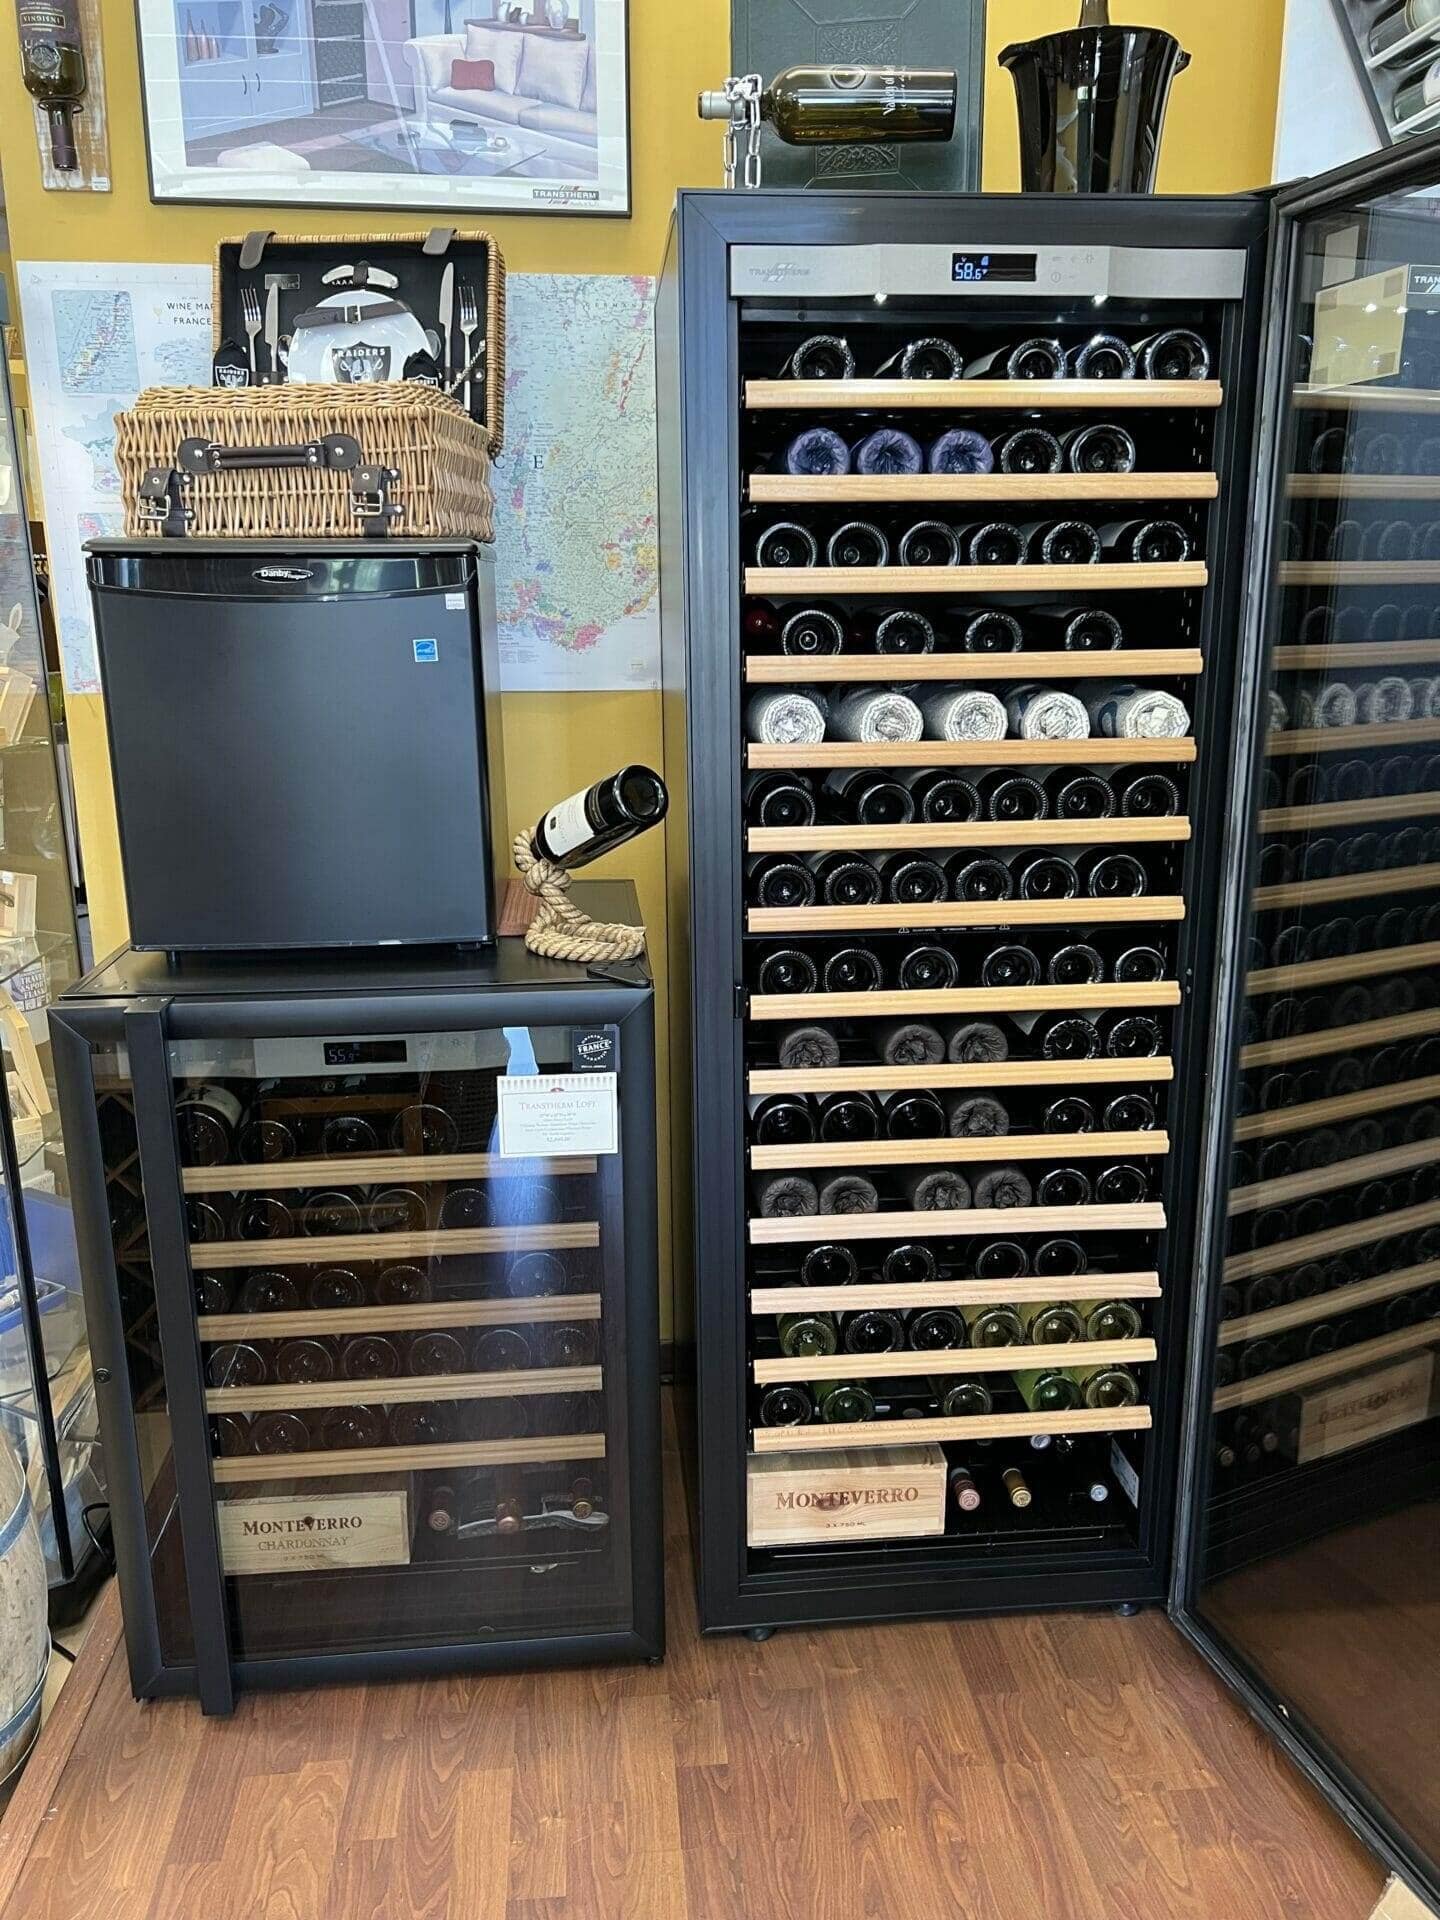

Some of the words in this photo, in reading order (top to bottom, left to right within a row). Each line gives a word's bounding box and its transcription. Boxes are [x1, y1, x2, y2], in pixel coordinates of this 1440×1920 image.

[534, 190, 597, 200] TRANSTHERM
[166, 302, 192, 310] WINE
[173, 317, 212, 326] FRANCE
[337, 348, 386, 357] RAIDERS
[260, 569, 289, 578] Danby
[578, 1041, 610, 1053] FRANCE
[776, 1487, 919, 1510] MONTEVERRO
[242, 1516, 363, 1536] MONTEVERRO
[258, 1536, 350, 1551] CHARDONNAY
